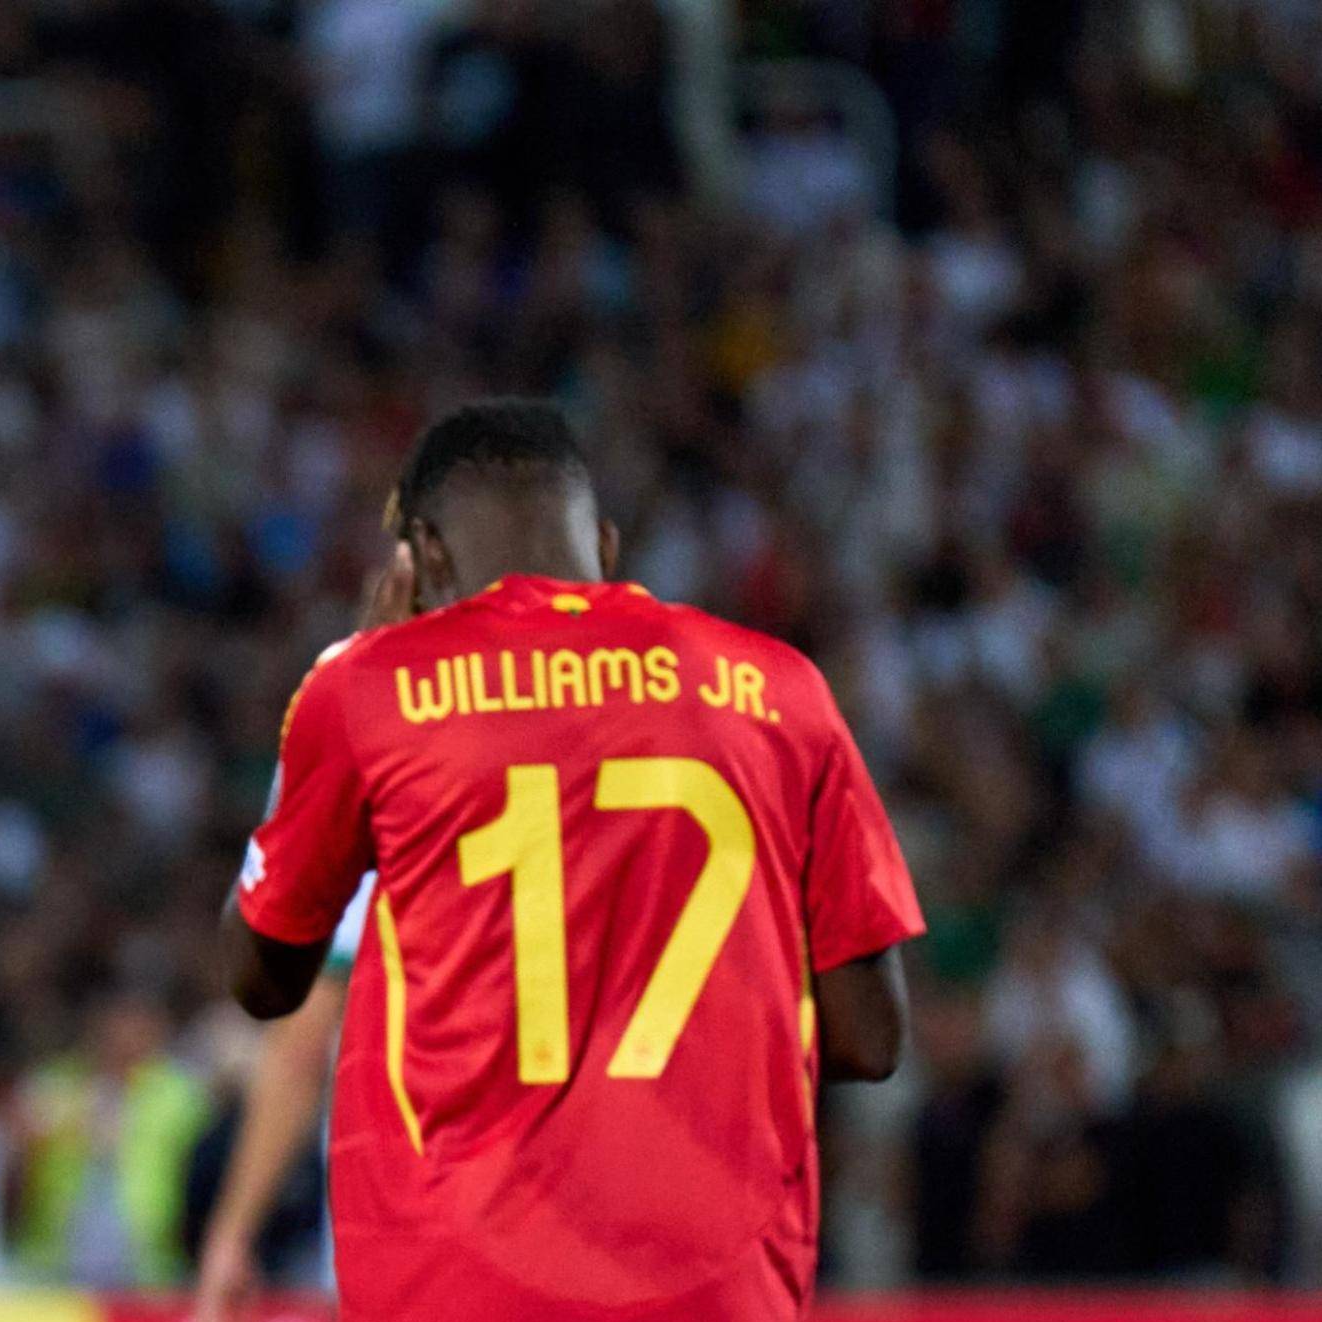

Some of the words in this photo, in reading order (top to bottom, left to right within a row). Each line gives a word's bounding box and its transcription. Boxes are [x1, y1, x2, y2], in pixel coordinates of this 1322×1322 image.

[396, 645, 680, 724] WILLIAMS
[698, 656, 780, 723] JR.
[459, 757, 755, 1084] 17
